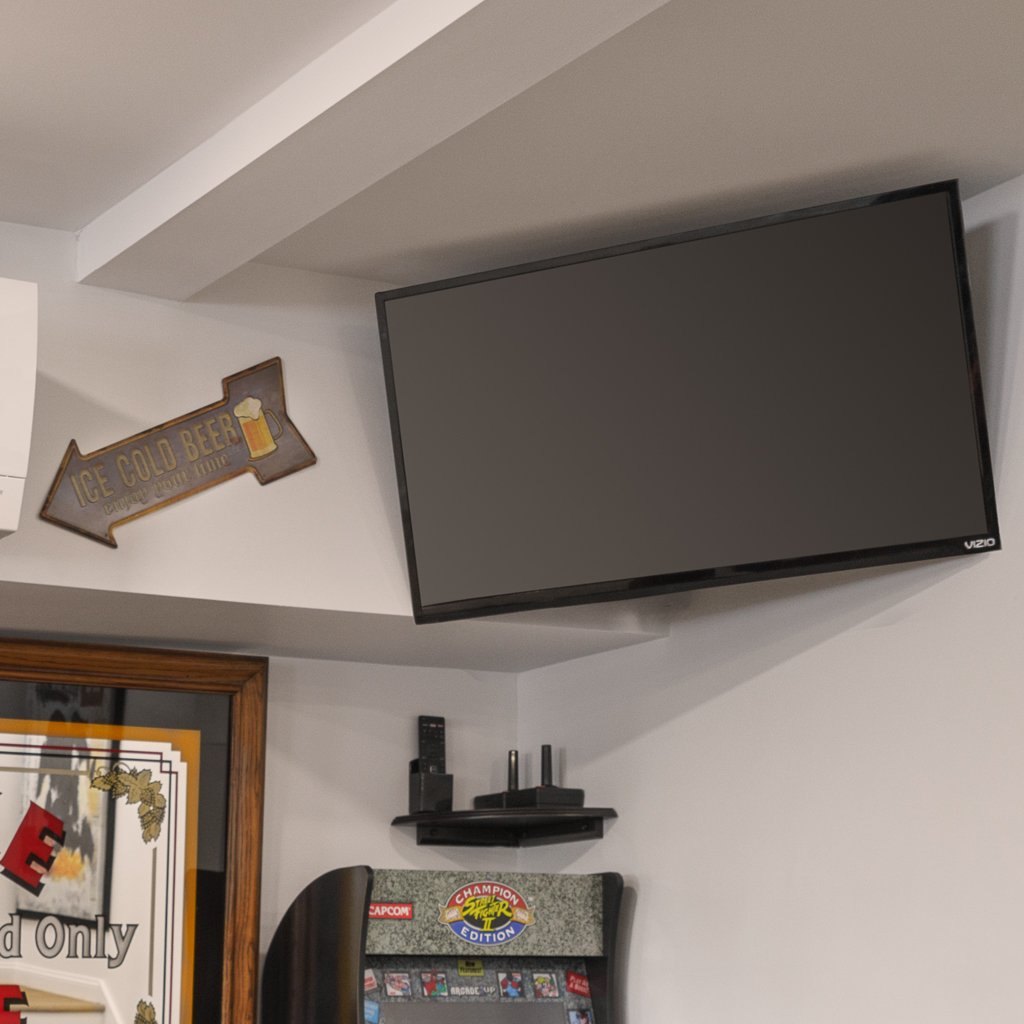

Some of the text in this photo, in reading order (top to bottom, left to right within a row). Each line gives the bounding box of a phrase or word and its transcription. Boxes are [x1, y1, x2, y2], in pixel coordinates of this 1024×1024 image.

[70, 411, 241, 508] ICE COLD BEER
[964, 538, 996, 550] VIZIO
[455, 885, 519, 905] CHAMPION
[369, 905, 410, 916] CAPCOM
[35, 914, 139, 969] Only
[460, 926, 515, 942] EDITION
